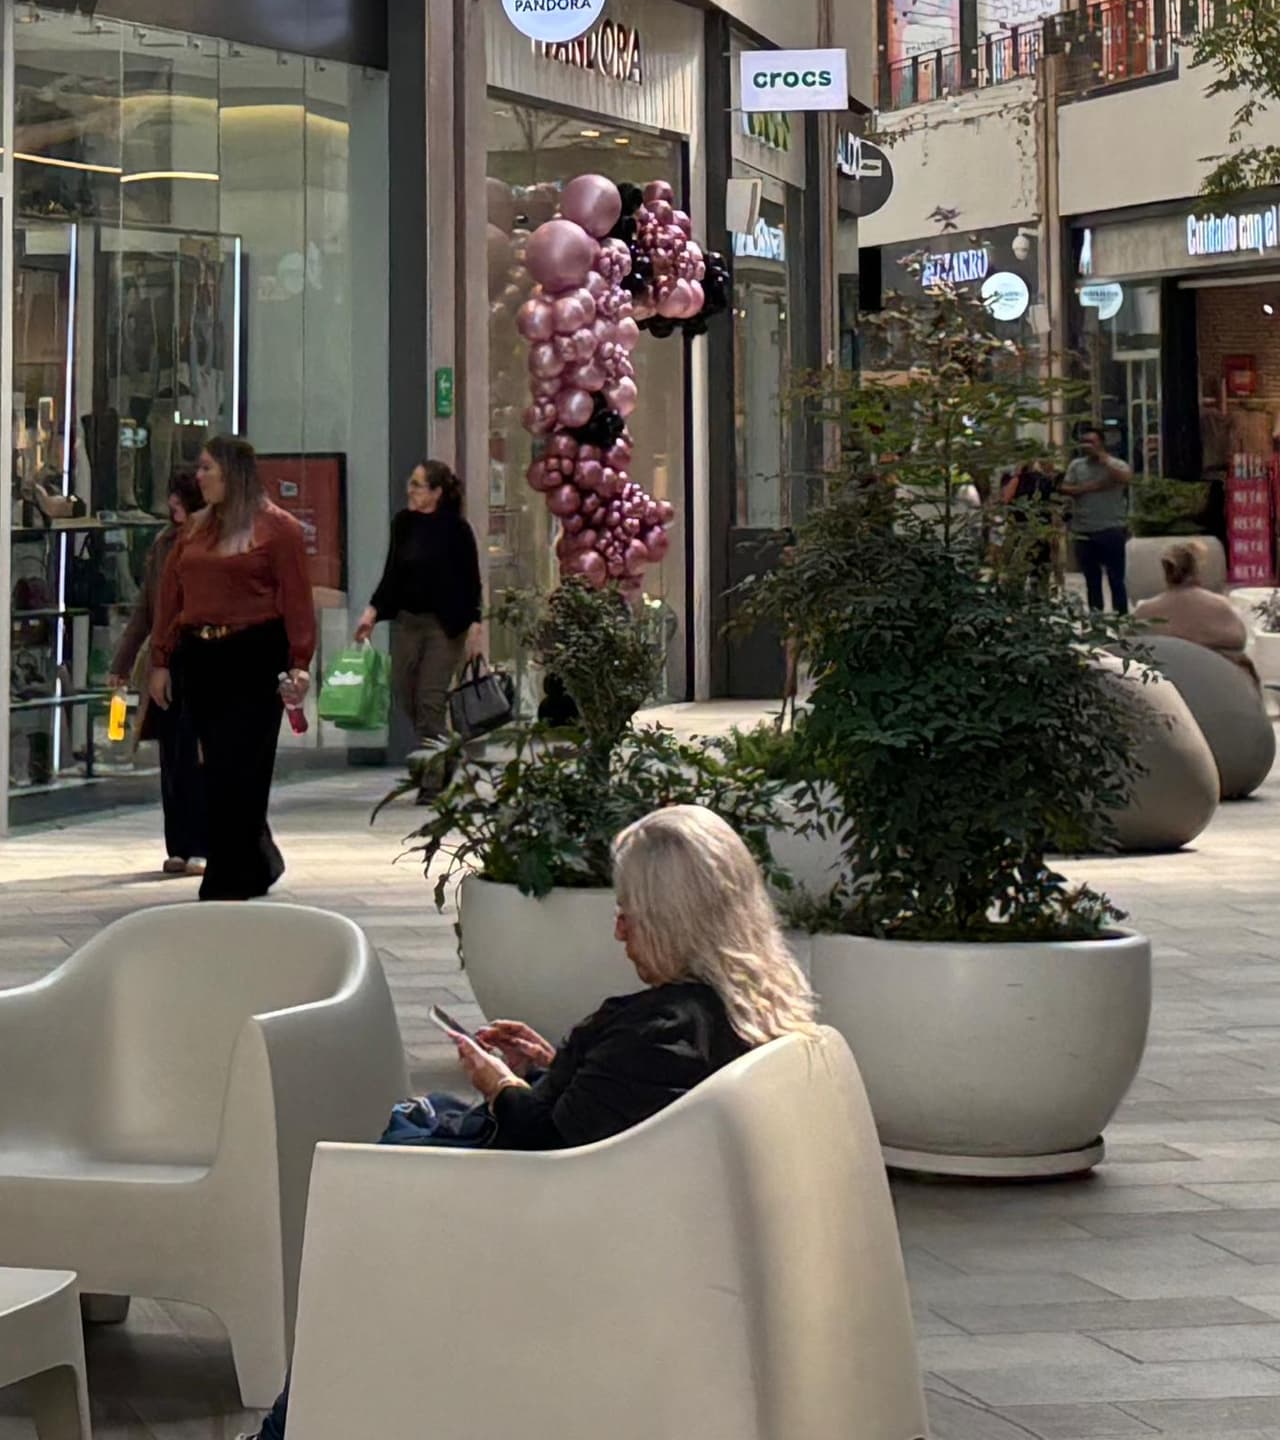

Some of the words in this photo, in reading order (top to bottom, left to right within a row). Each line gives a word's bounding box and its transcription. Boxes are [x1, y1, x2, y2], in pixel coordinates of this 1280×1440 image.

[752, 70, 833, 89] crocs
[1186, 212, 1238, 255] Cuidado
[1238, 213, 1264, 256] con
[1264, 204, 1277, 247] el
